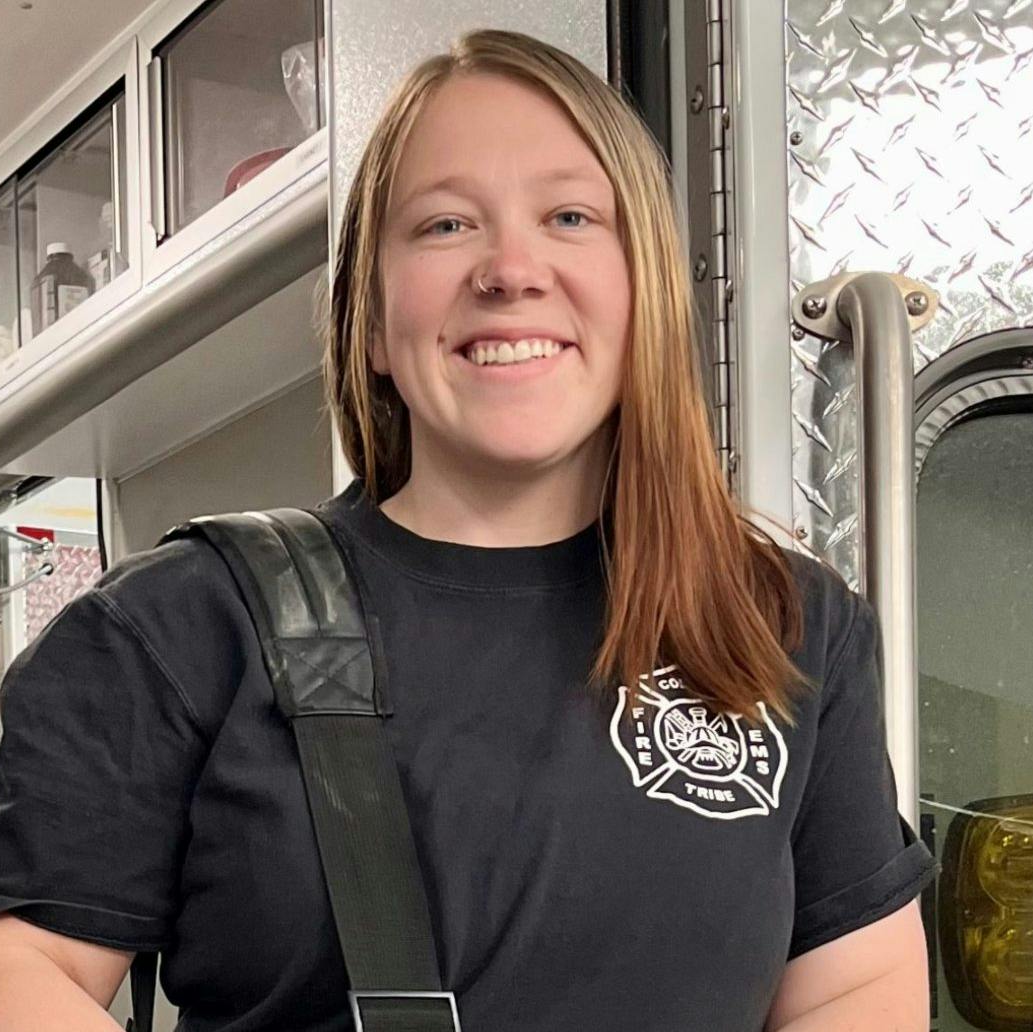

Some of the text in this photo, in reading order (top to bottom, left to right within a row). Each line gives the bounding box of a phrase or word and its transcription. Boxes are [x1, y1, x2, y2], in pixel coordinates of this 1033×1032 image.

[632, 706, 653, 767] FIRE
[748, 729, 770, 776] EMS
[684, 782, 736, 803] TRIBE
